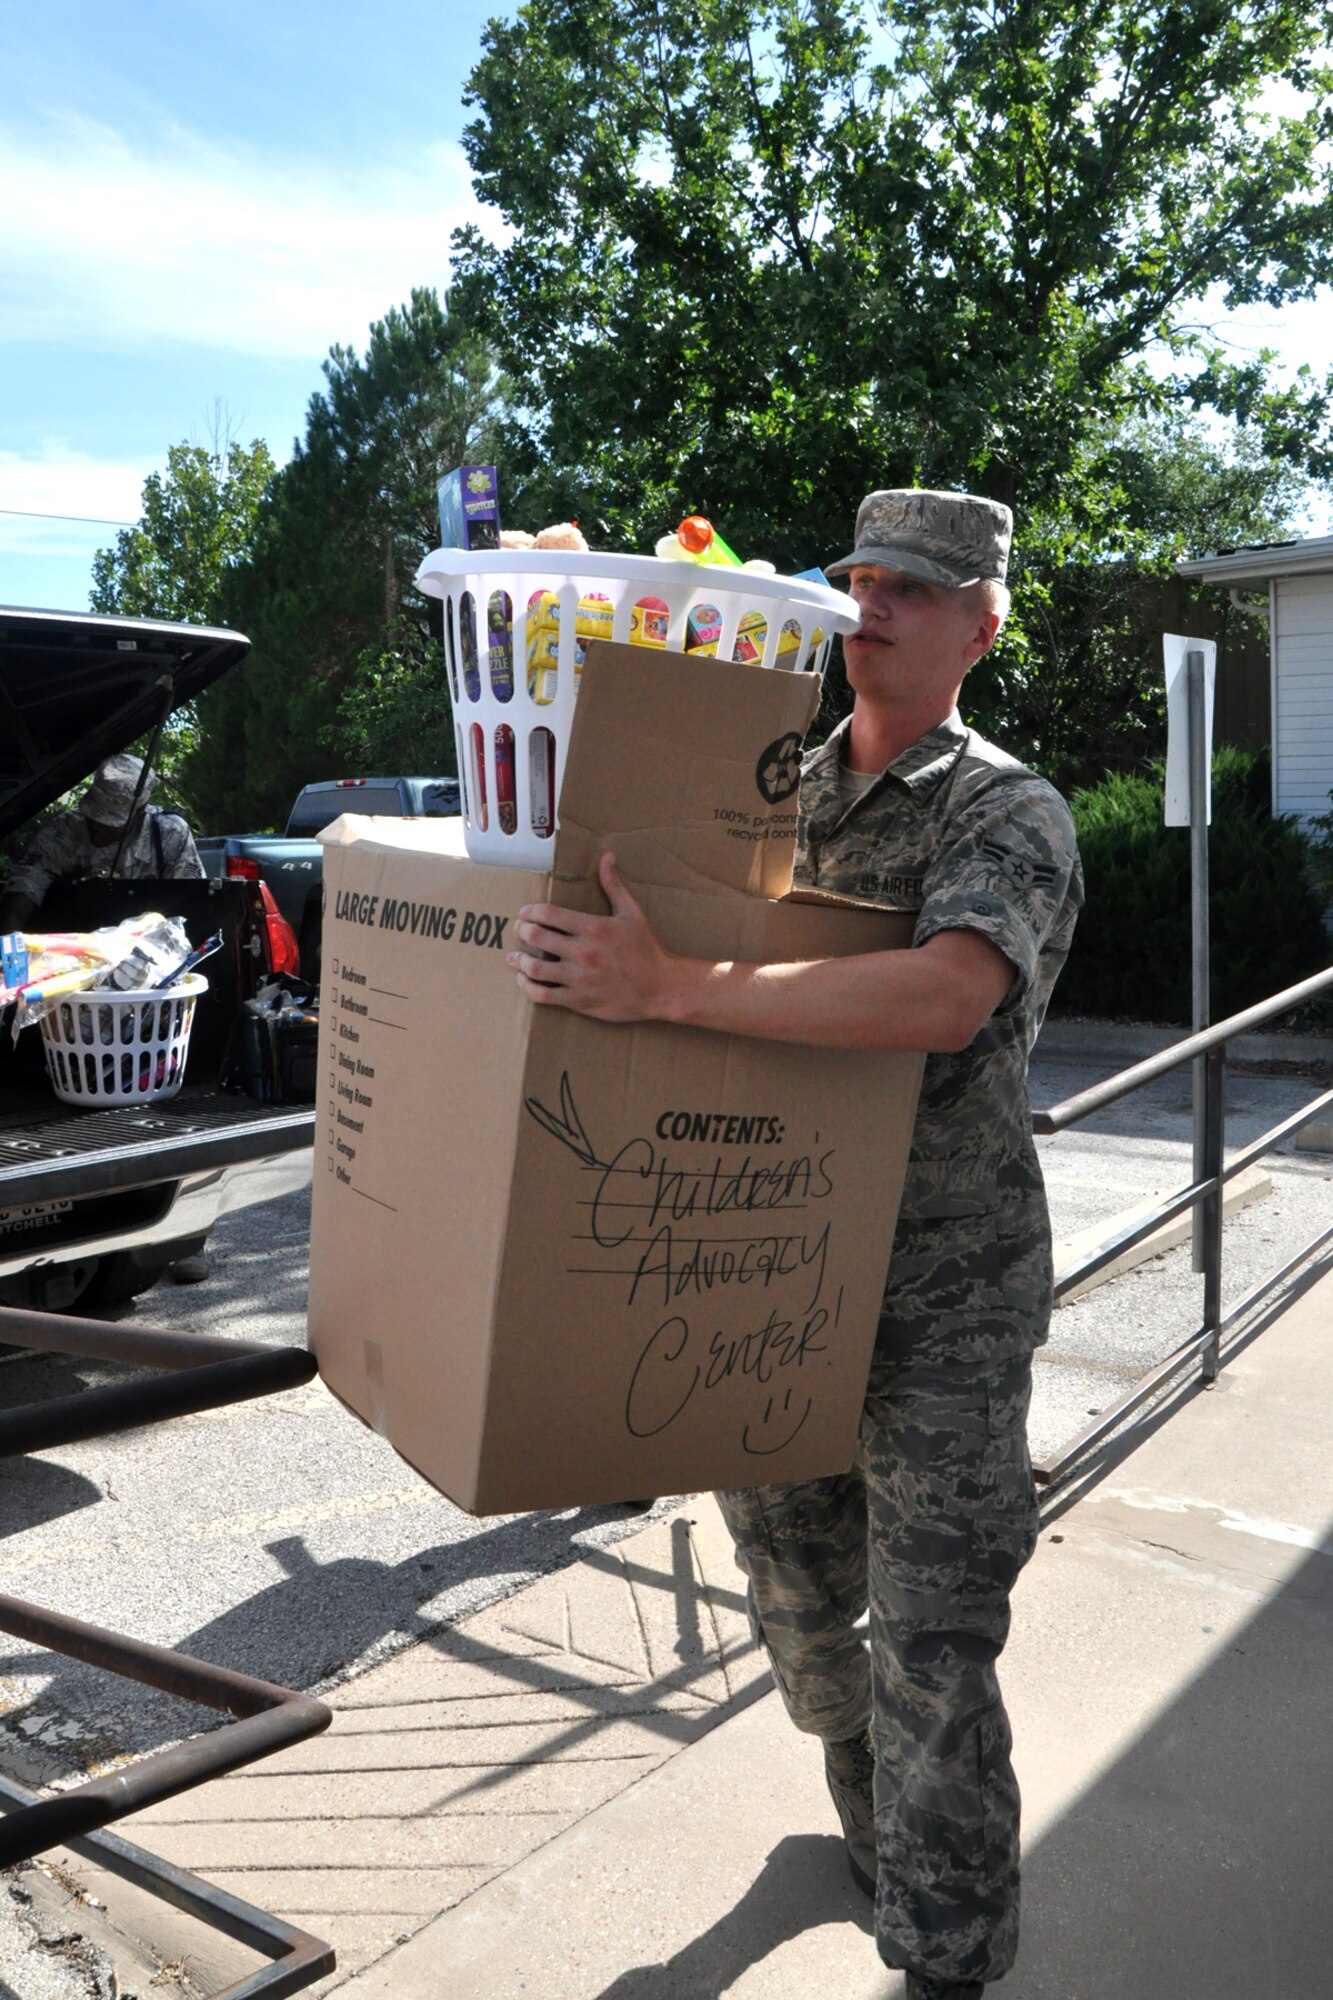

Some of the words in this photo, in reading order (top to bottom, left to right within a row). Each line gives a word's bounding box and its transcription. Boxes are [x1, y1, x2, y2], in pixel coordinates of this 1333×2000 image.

[713, 808, 750, 825] 100%
[881, 876, 902, 895] AIR
[335, 890, 379, 926] LARGE
[379, 898, 457, 941] MOVING
[460, 911, 509, 950] BOX
[342, 965, 367, 986] Bedroom
[341, 994, 368, 1016] Bathroom
[340, 1023, 360, 1043] Kitchen
[338, 1052, 355, 1075] Dining
[356, 1059, 375, 1079] Room
[338, 1081, 353, 1104] Living
[354, 1088, 372, 1108] Room
[337, 1109, 364, 1134] Basement
[656, 1111, 785, 1145] CONTENTS:
[336, 1138, 356, 1161] Garage
[336, 1166, 351, 1185] Other
[0, 1214, 61, 1235] ITCHELL
